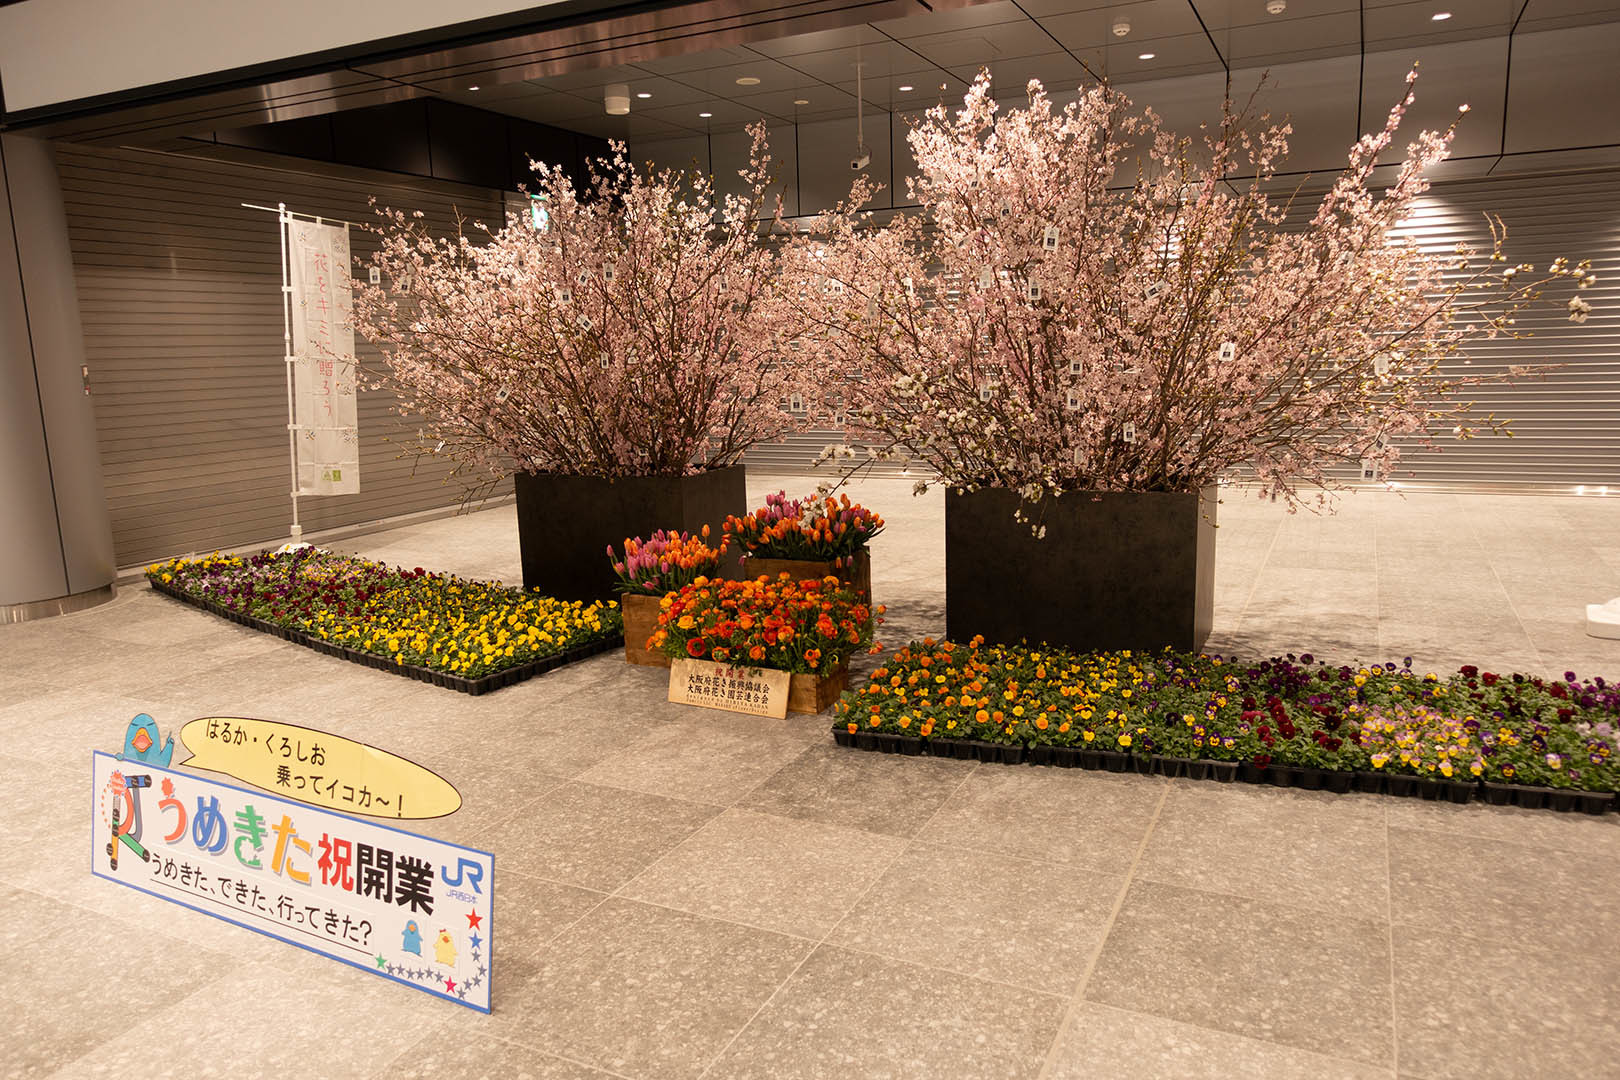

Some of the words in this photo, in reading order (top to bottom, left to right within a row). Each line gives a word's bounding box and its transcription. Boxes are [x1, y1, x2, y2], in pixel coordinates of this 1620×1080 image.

[687, 684, 769, 705] 大阪府花き園芸連合会
[688, 674, 770, 694] 大阪府花き振興協議会
[205, 719, 326, 766] はるか・くろしお
[157, 777, 435, 916] うめきた祝開業
[441, 857, 483, 895] JR
